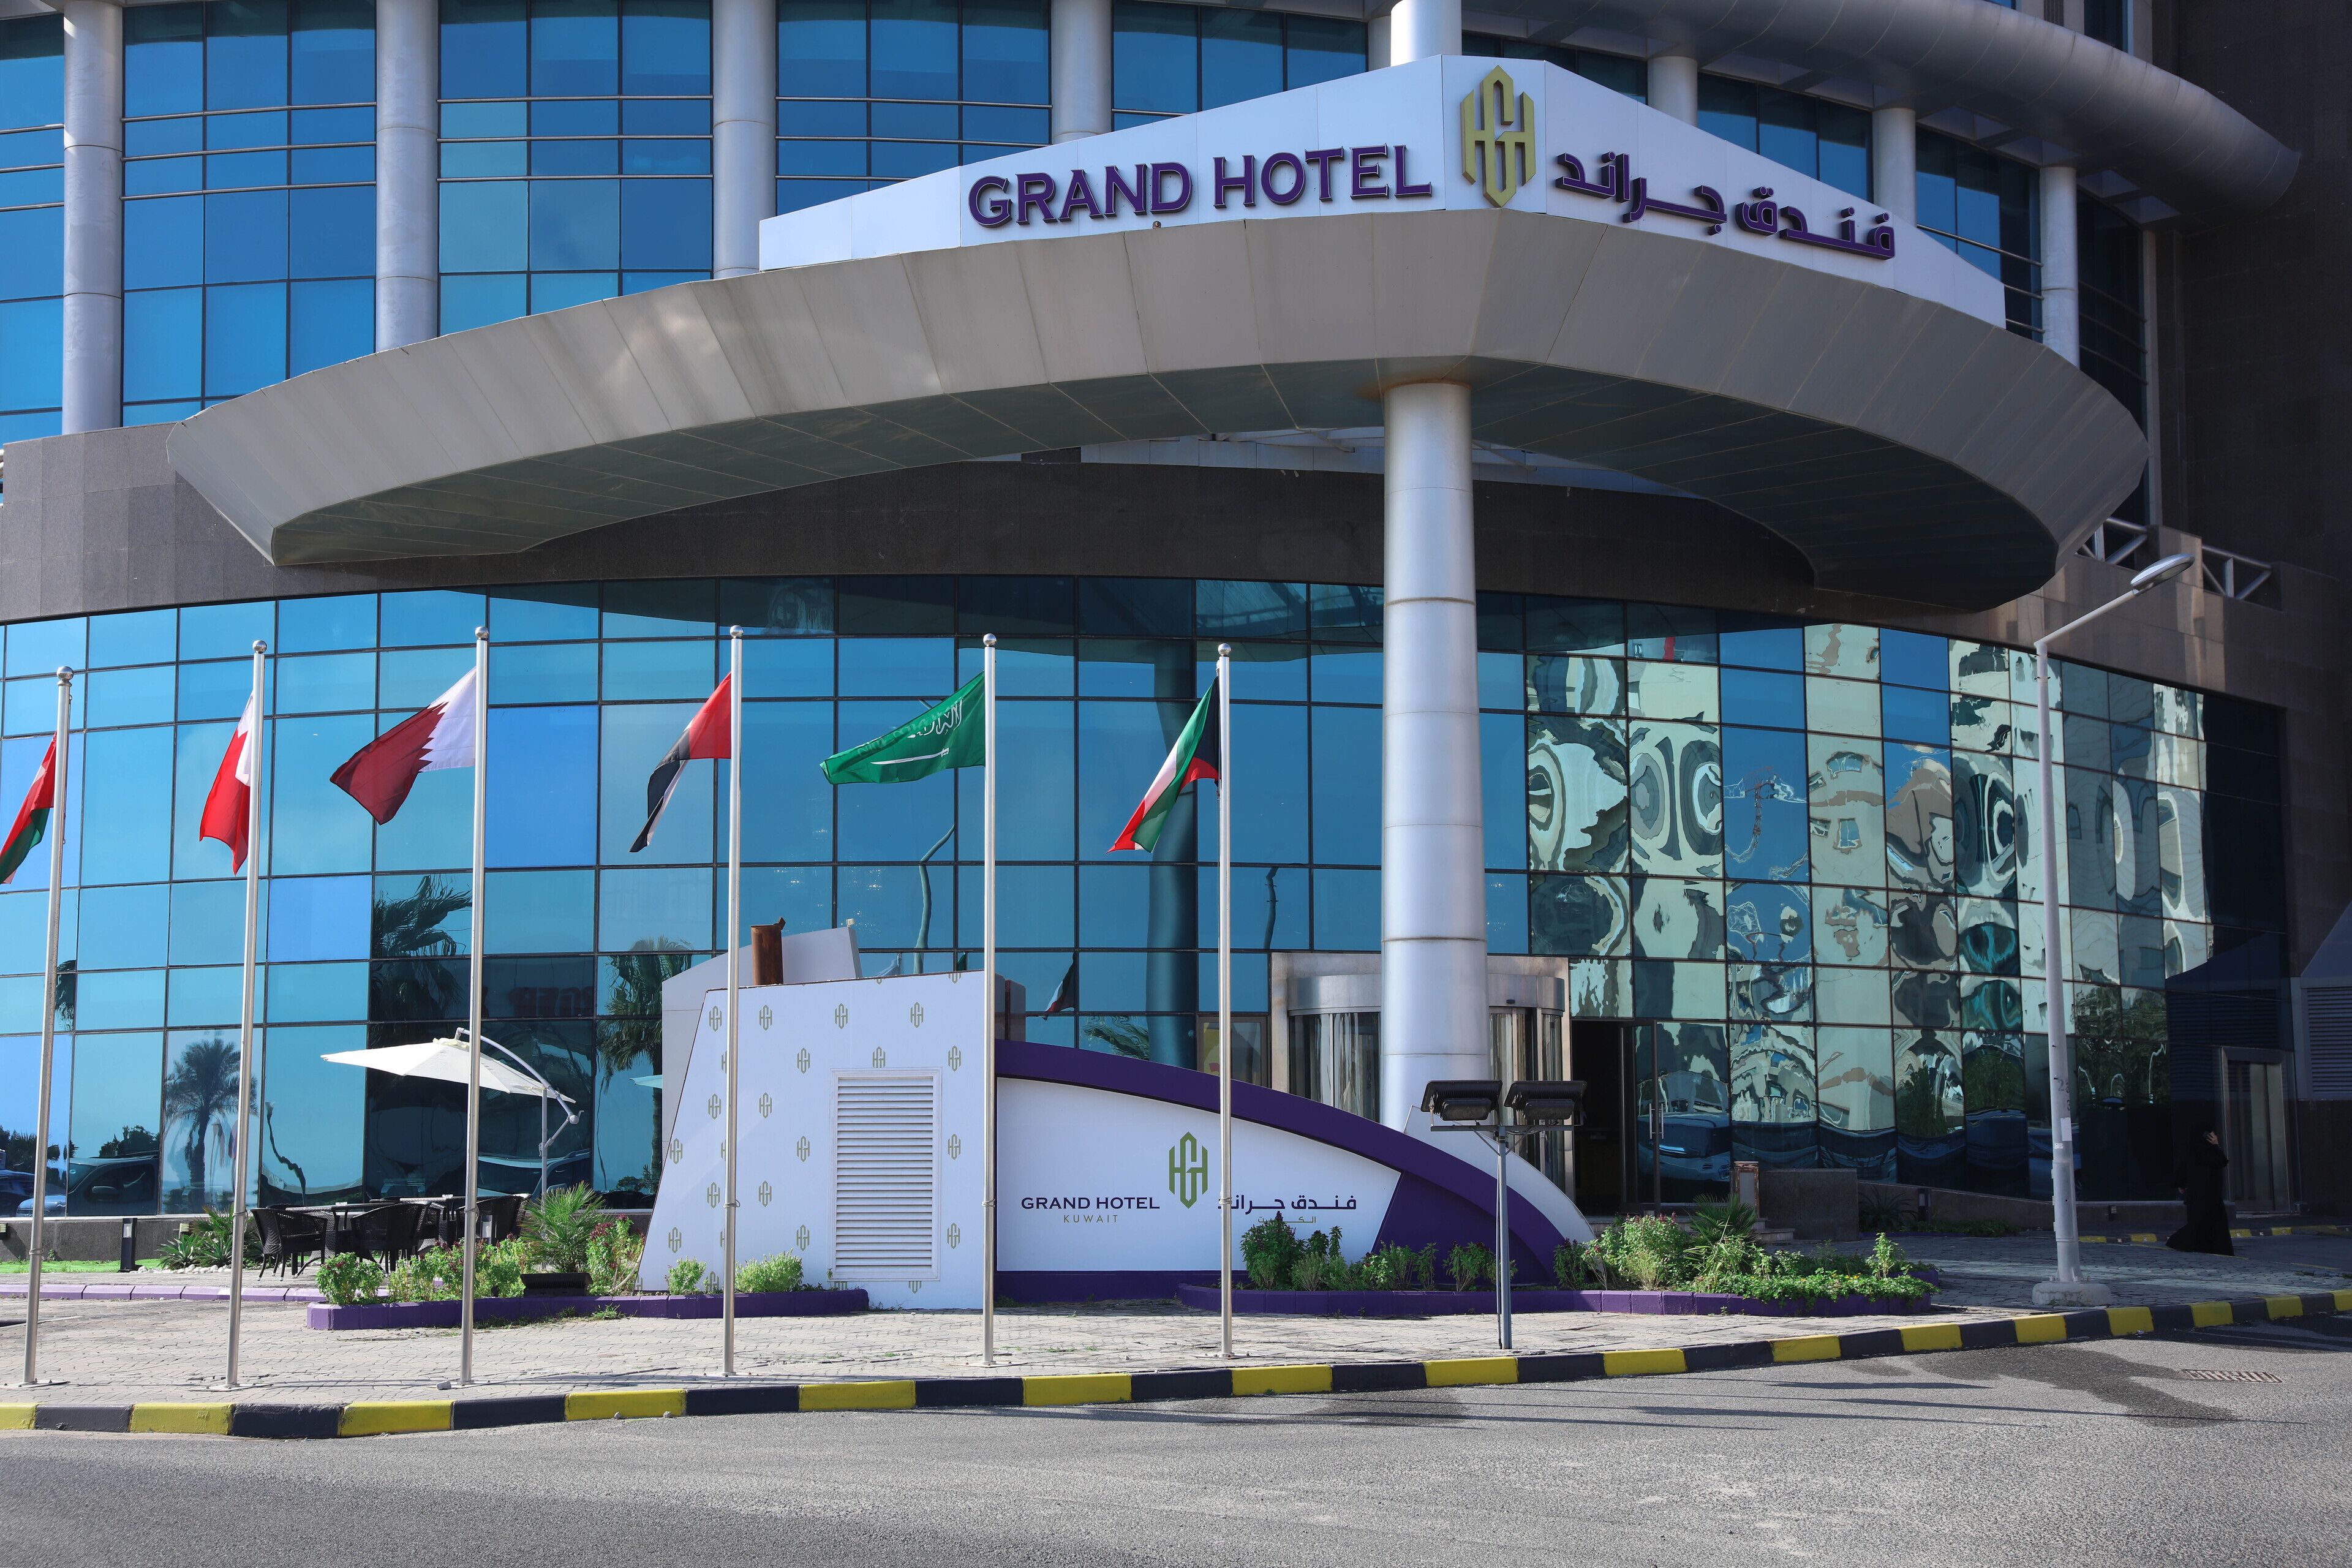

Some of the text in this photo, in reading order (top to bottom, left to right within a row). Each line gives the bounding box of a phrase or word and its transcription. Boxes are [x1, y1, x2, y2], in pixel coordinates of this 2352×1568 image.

[968, 144, 1433, 228] GRAND HOTEL
[1555, 151, 1896, 260] فندق جراند
[1021, 1197, 1160, 1210] GRAND HOTEL
[1291, 1195, 1357, 1210] فندق
[1063, 1214, 1118, 1224] KUWAIT
